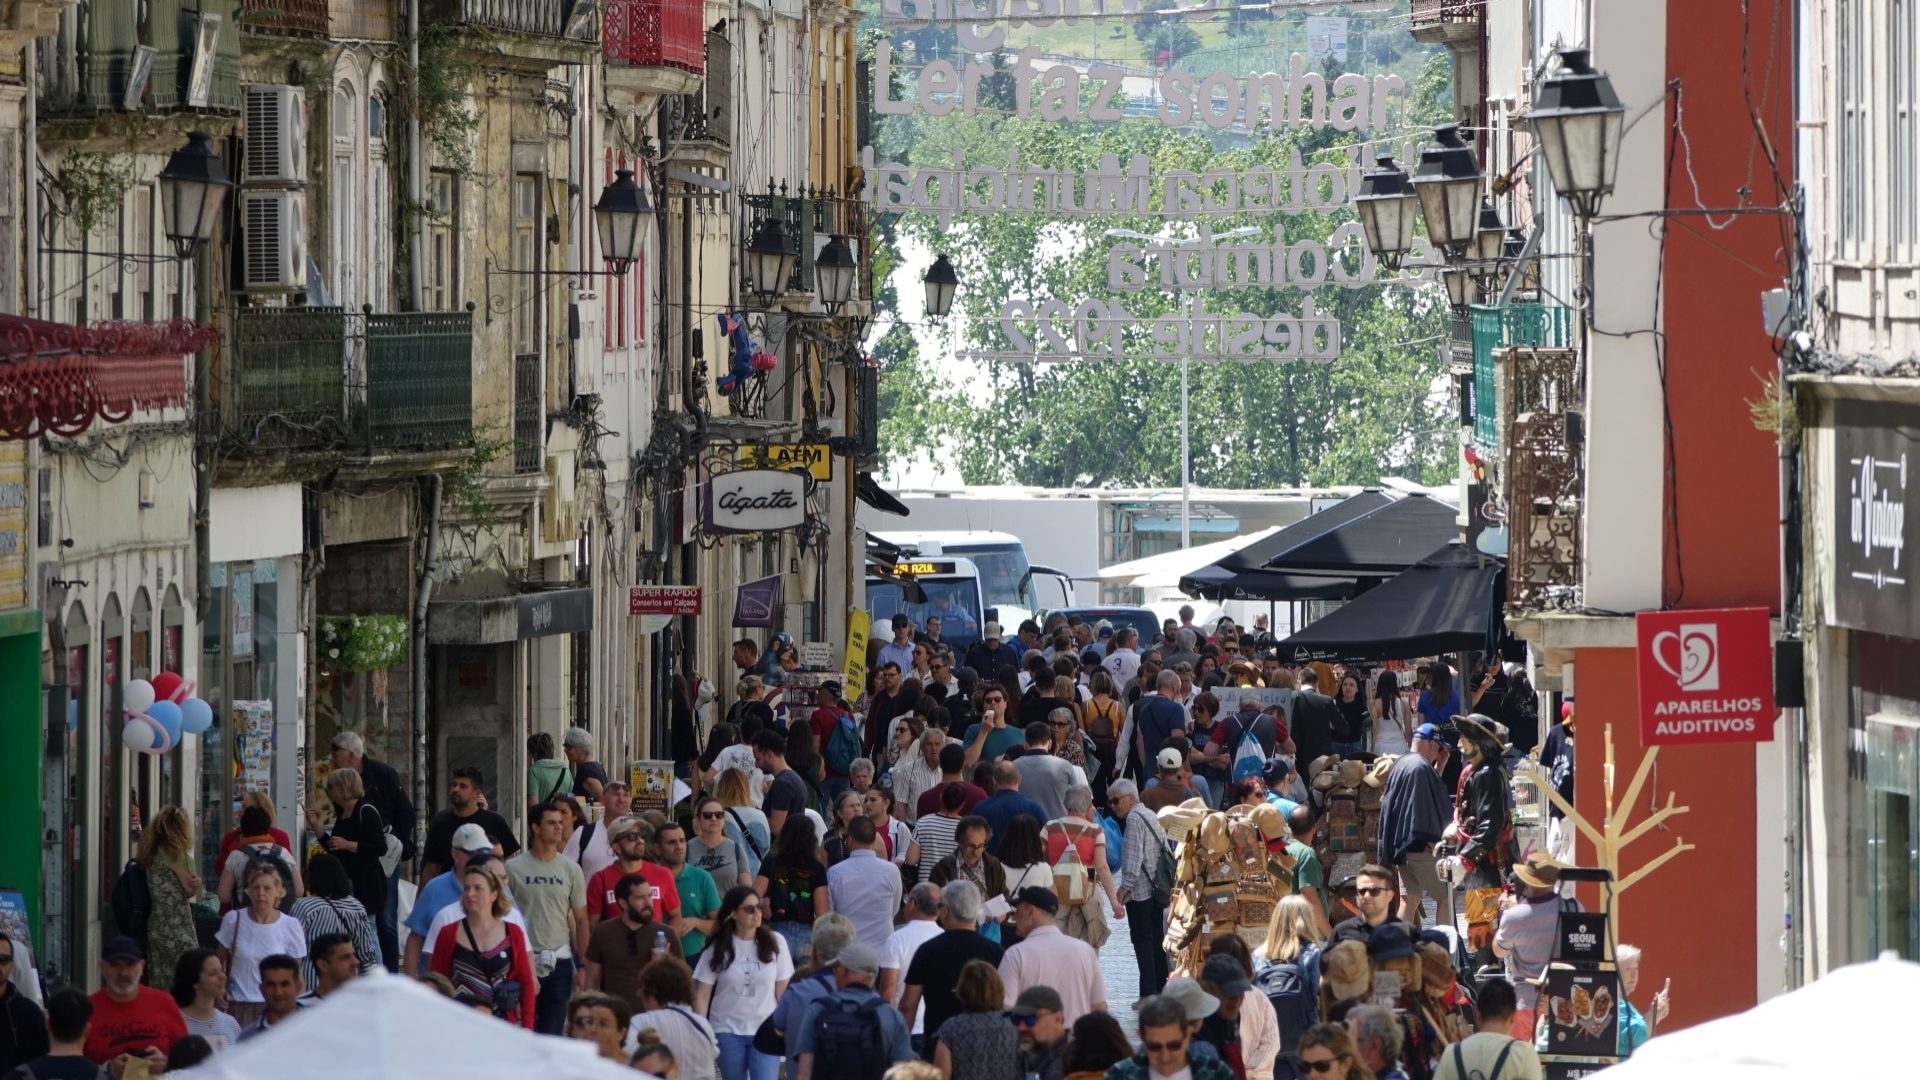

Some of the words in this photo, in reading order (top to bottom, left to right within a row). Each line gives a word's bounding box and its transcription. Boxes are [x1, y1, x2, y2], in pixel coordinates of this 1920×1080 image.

[874, 39, 994, 117] Ler
[1013, 46, 1125, 123] faz
[1158, 52, 1404, 132] sonhar
[778, 448, 822, 462] ATM
[911, 563, 936, 574] AZUL
[632, 588, 660, 597] SUPER
[1654, 698, 1762, 715] APARELHOS
[1656, 717, 1756, 735] AUDITIVOS
[1568, 933, 1597, 944] SEOUL
